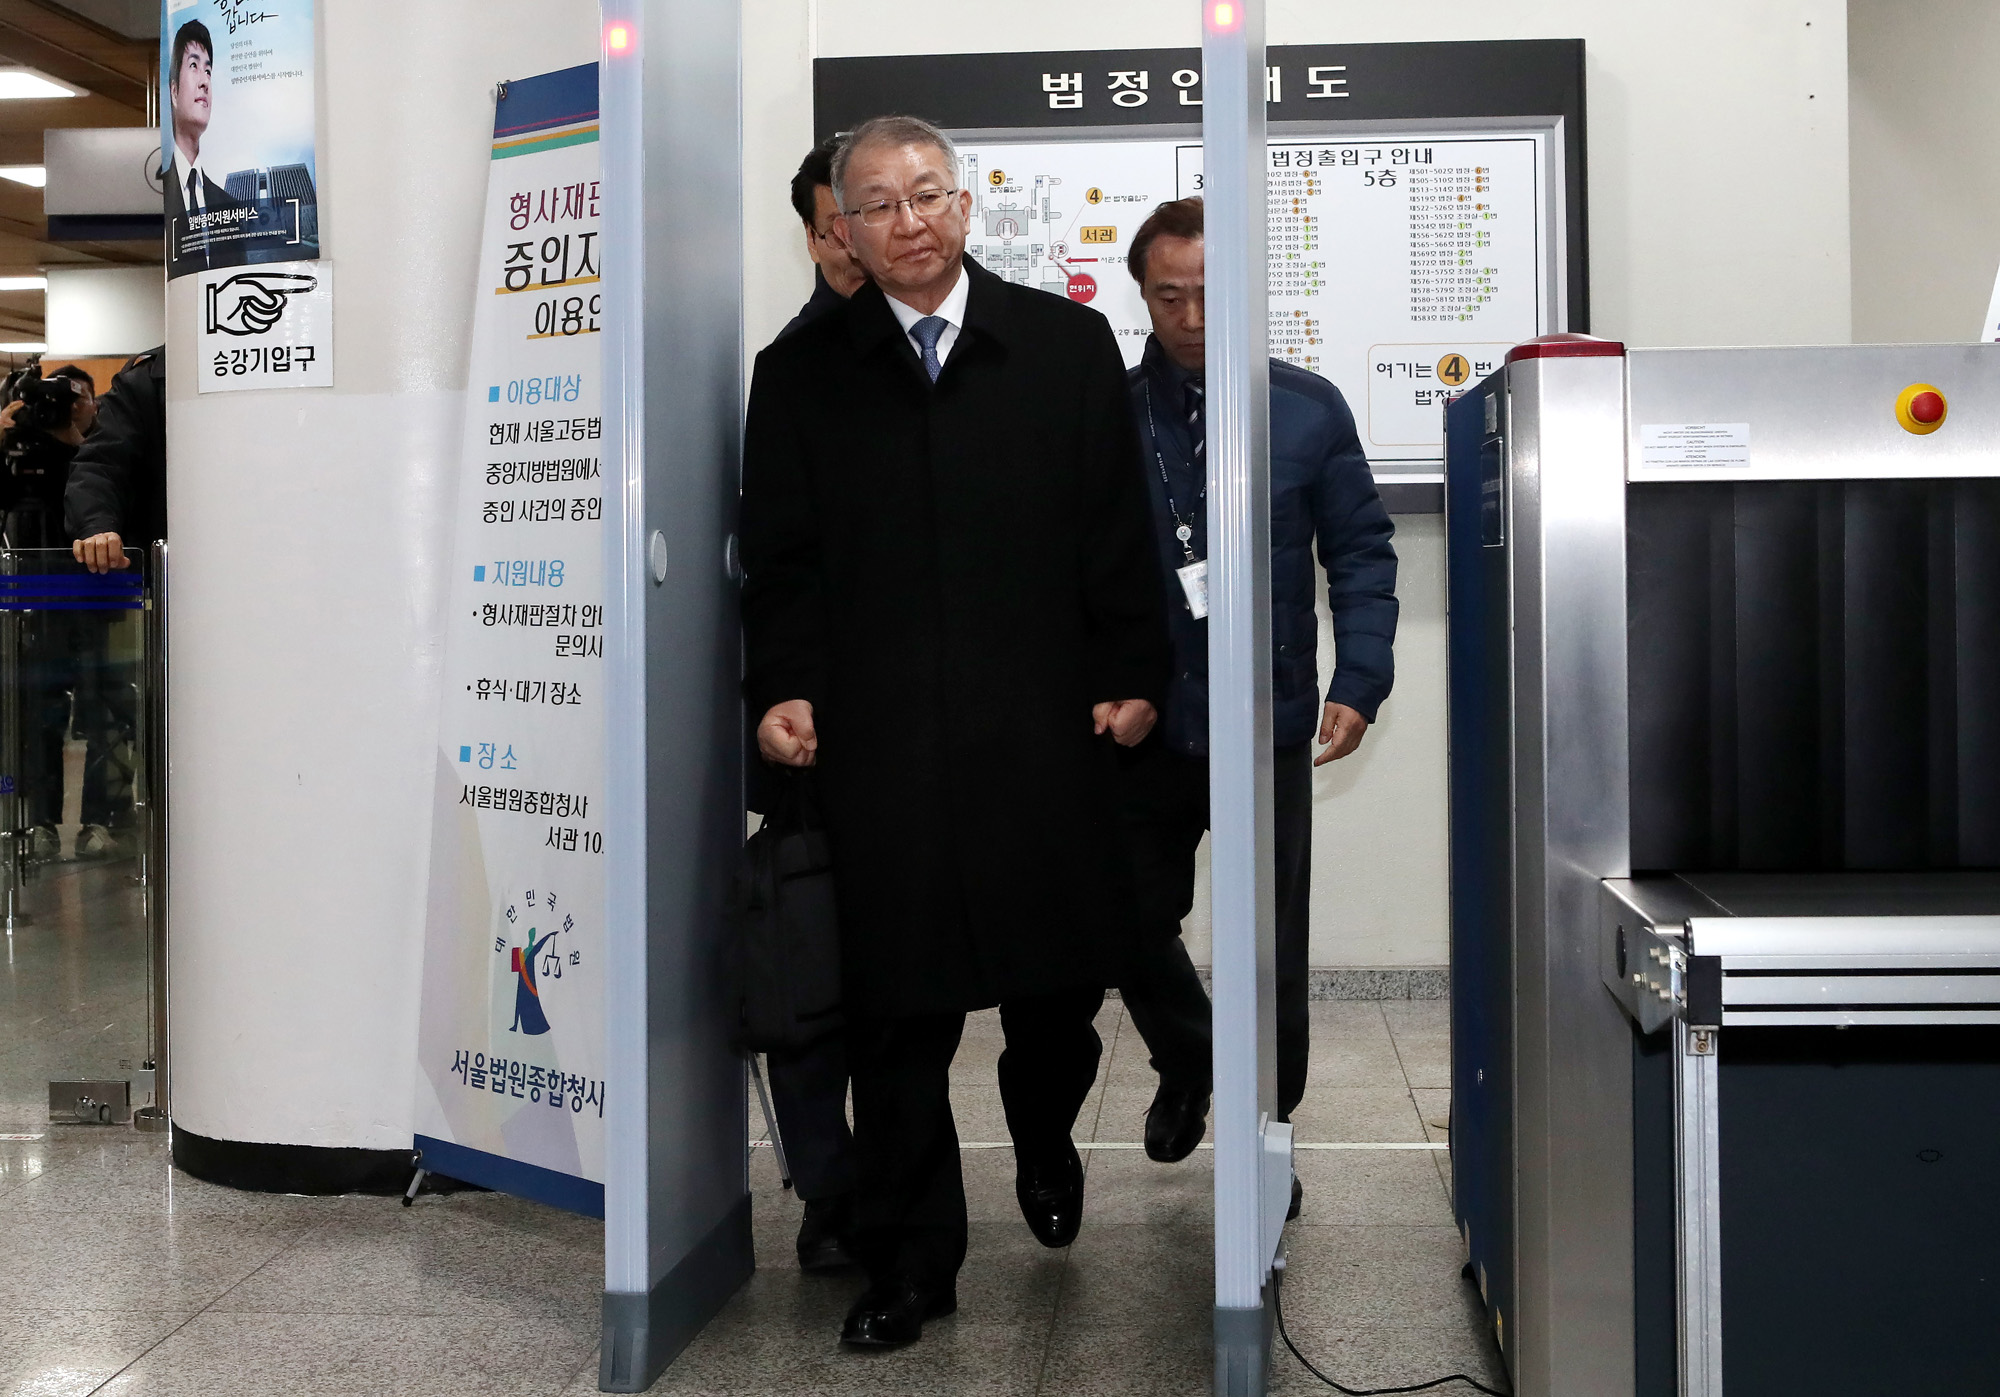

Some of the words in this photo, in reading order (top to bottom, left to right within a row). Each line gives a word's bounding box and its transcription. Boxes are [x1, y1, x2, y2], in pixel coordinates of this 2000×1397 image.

[222, 7, 279, 34] 갑니다
[1272, 149, 1382, 168] 법정출입구
[1391, 147, 1432, 165] 안내
[992, 170, 1002, 184] 5
[1364, 169, 1397, 187] 5층
[1089, 189, 1099, 202] 4
[188, 206, 259, 231] 일반증인지원서비스
[1084, 229, 1114, 242] 서관
[214, 346, 315, 377] 승강기입구
[1376, 362, 1432, 379] 여기는
[1444, 357, 1462, 382] 4
[1475, 362, 1492, 378] 번
[507, 374, 582, 405] 이용대상
[489, 421, 520, 445] 현재
[523, 416, 602, 443] 서울고등법
[482, 501, 514, 524] 중인
[518, 499, 566, 522] 사건의
[492, 560, 566, 587] 지원내용
[482, 603, 577, 627] 형사재판절차
[550, 681, 582, 706] 장소
[477, 742, 518, 771] 장소
[459, 784, 588, 819] 서울법원종합청사
[545, 826, 578, 851] 서관
[450, 1049, 605, 1119] 서울법원종합청사
